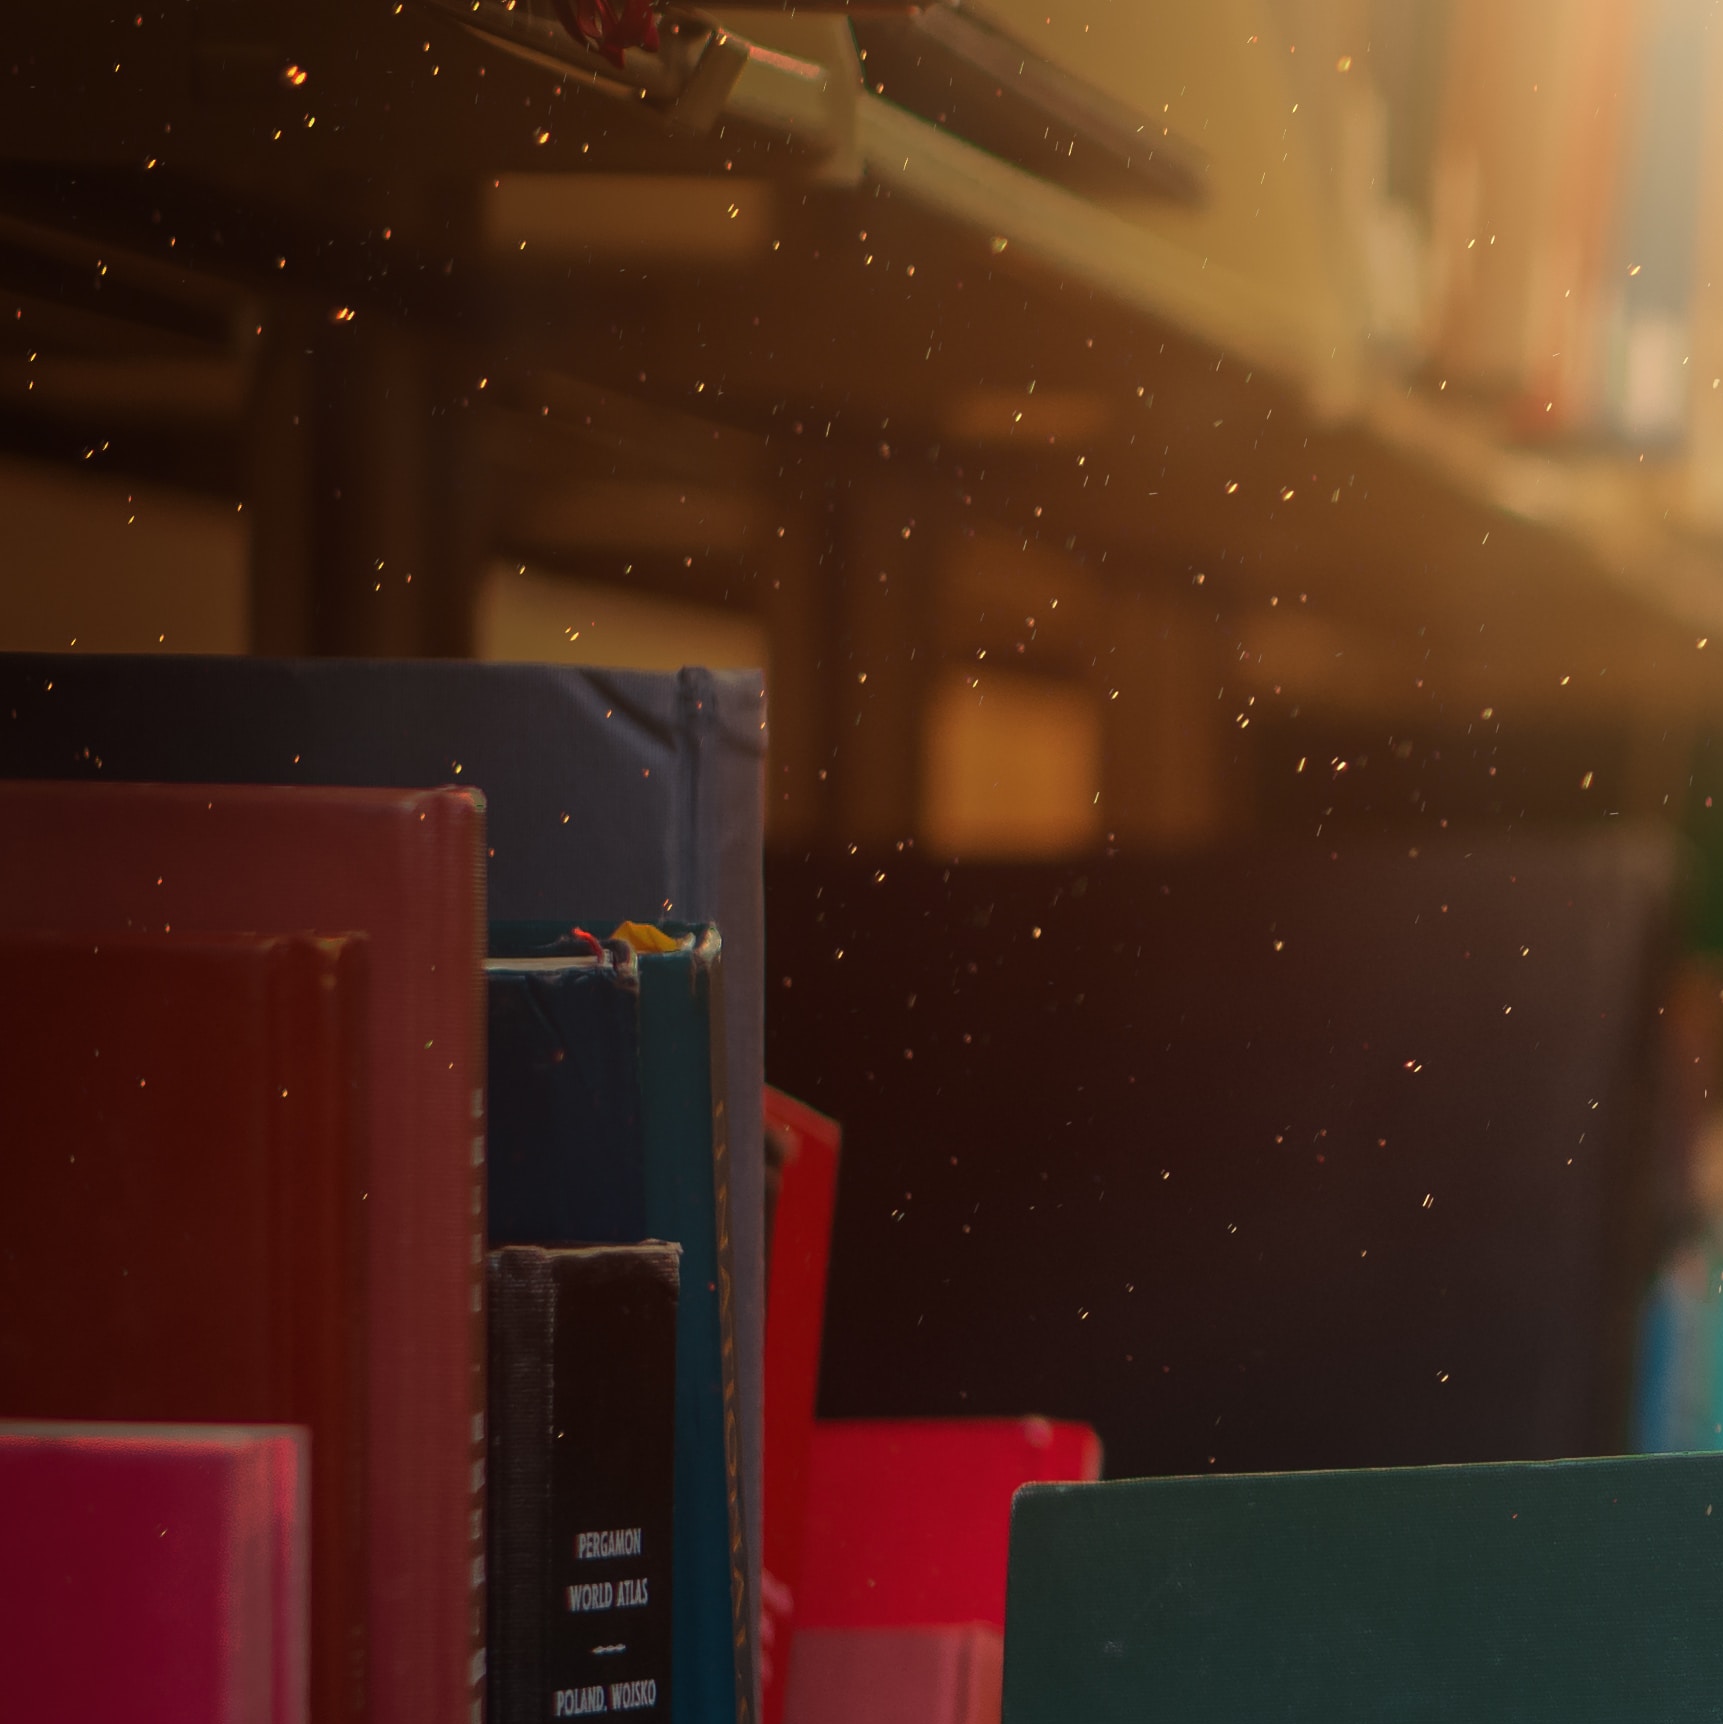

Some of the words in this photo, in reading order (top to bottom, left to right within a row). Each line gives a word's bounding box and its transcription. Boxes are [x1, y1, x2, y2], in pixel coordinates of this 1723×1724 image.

[576, 1528, 643, 1559] PERGAMON
[568, 1582, 613, 1612] WORLD
[616, 1577, 649, 1608] ATLAS
[611, 1679, 657, 1711] WOJSKO
